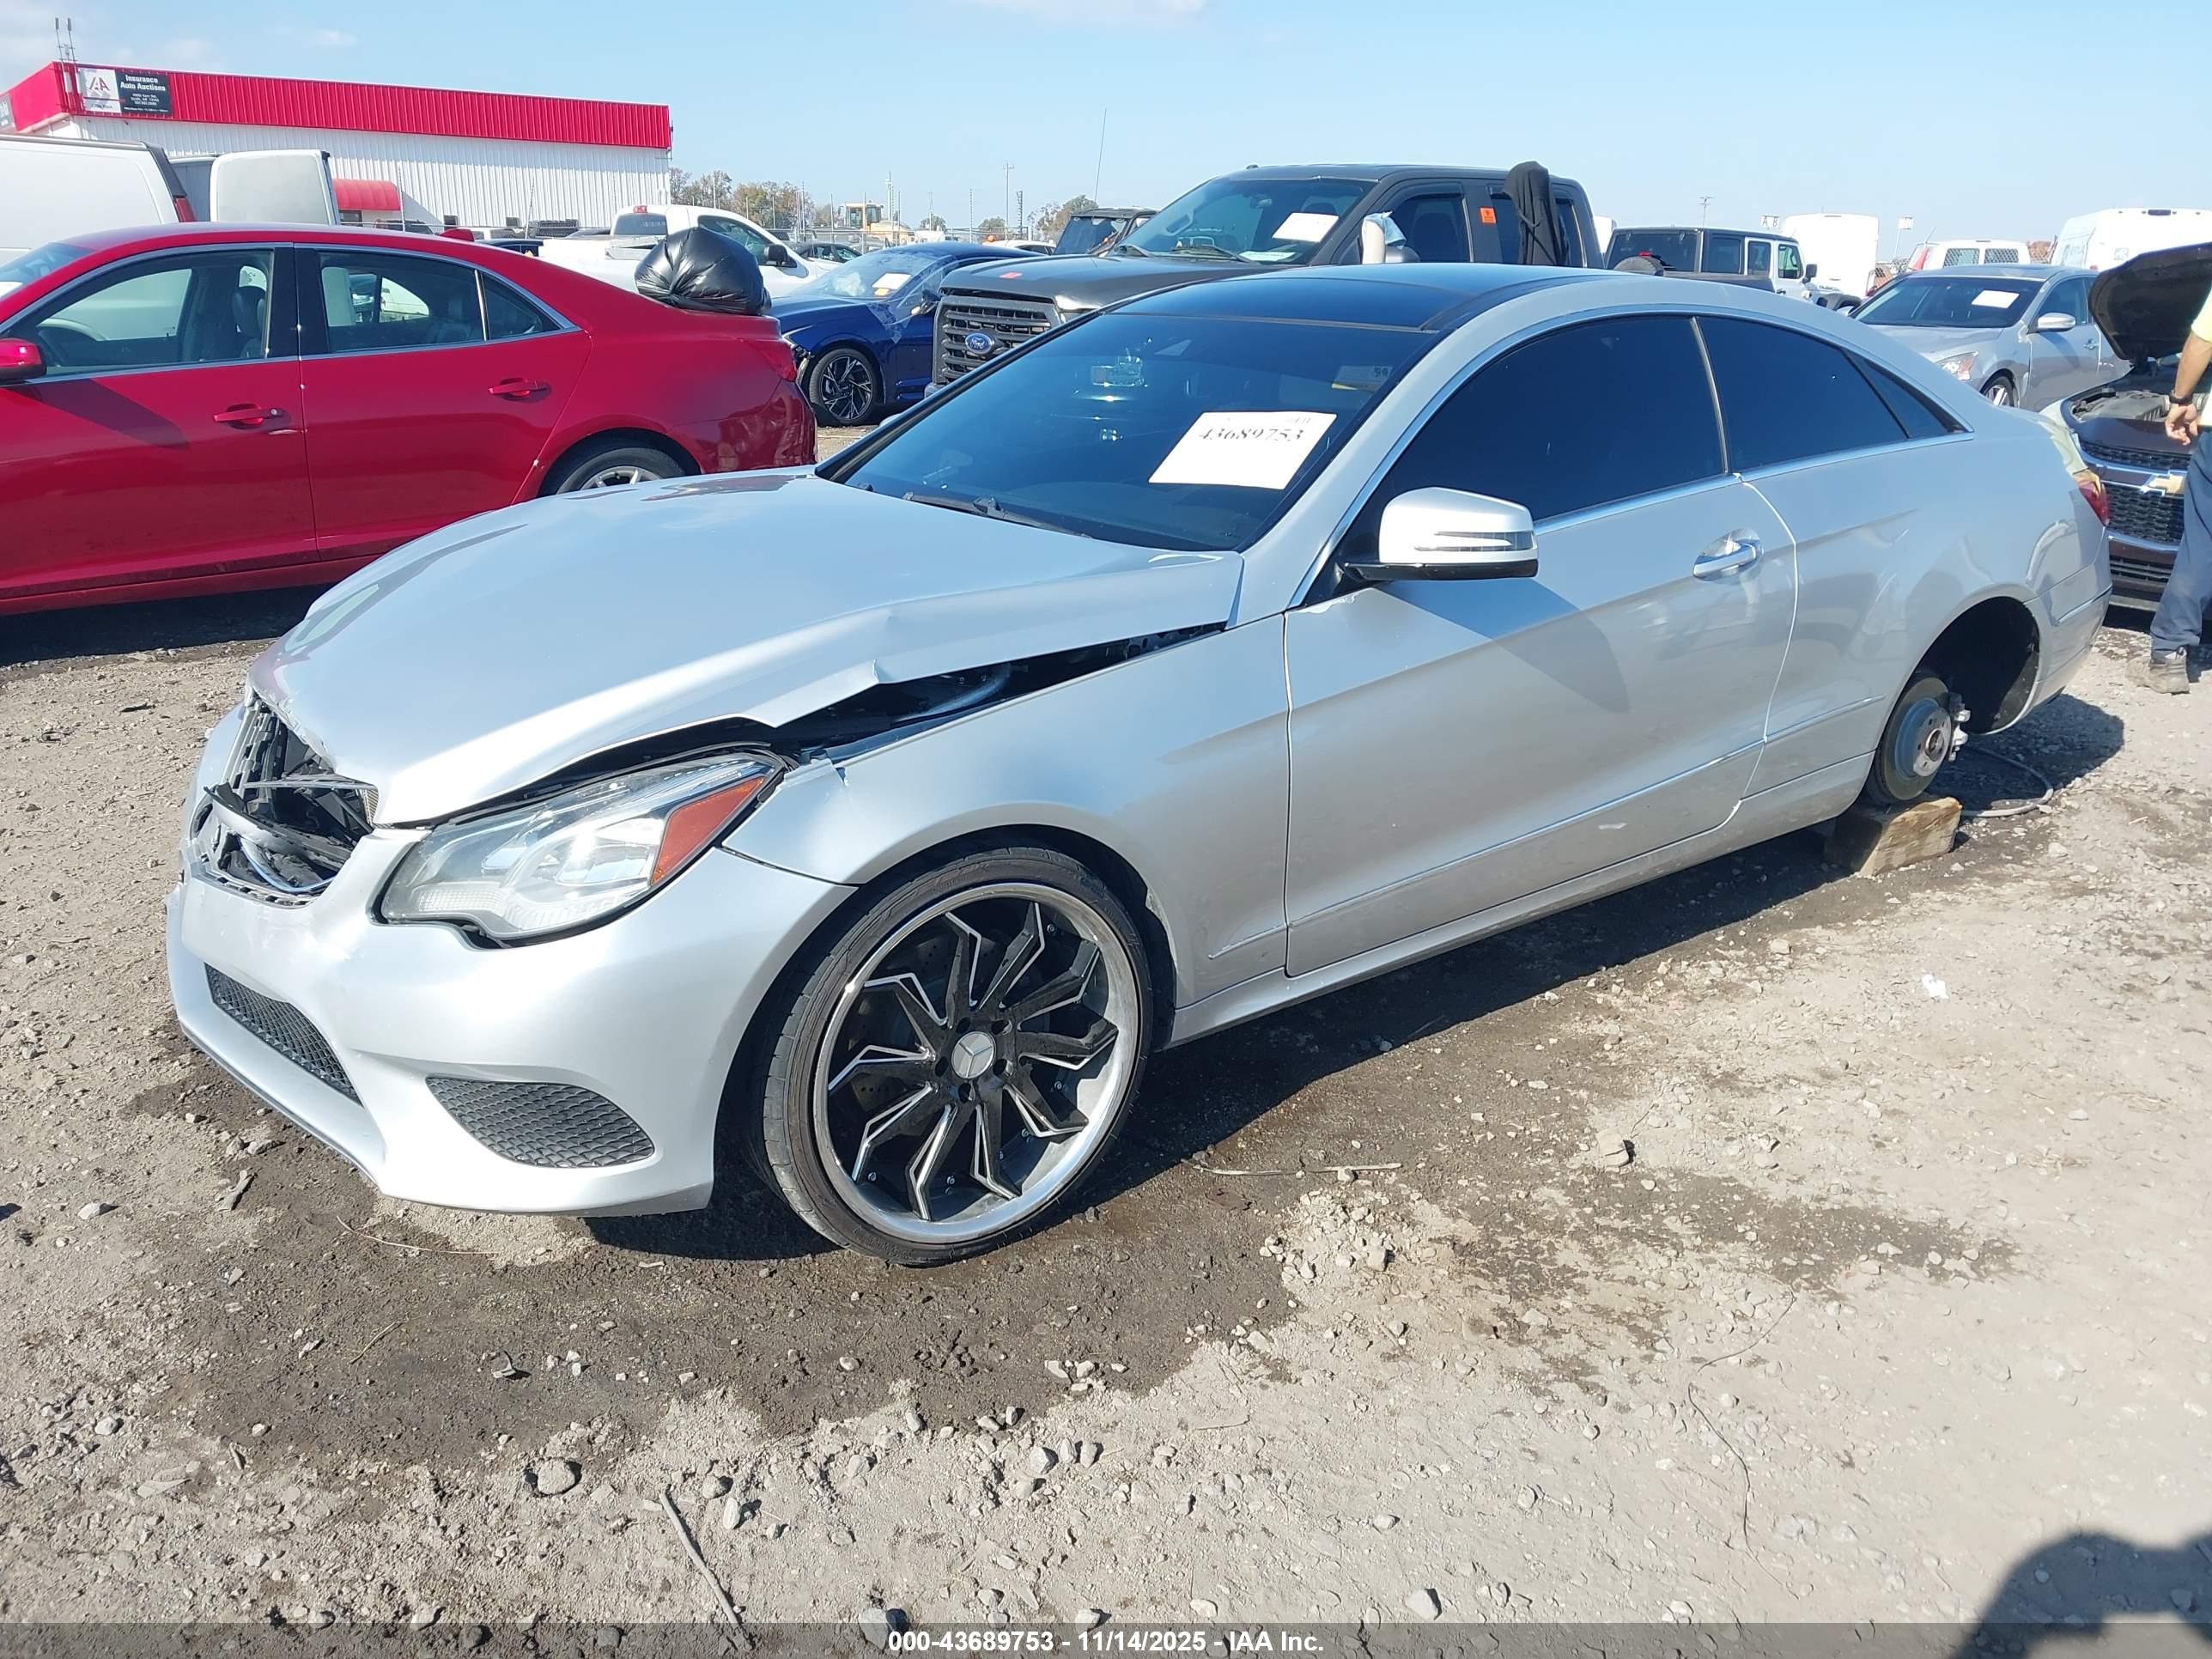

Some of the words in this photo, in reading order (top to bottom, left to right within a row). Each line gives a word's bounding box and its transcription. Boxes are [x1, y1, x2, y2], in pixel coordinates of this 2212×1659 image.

[125, 74, 158, 83] Insurance
[120, 81, 137, 89] Auto
[137, 82, 166, 92] Auctions
[1199, 428, 1304, 441] 43689753
